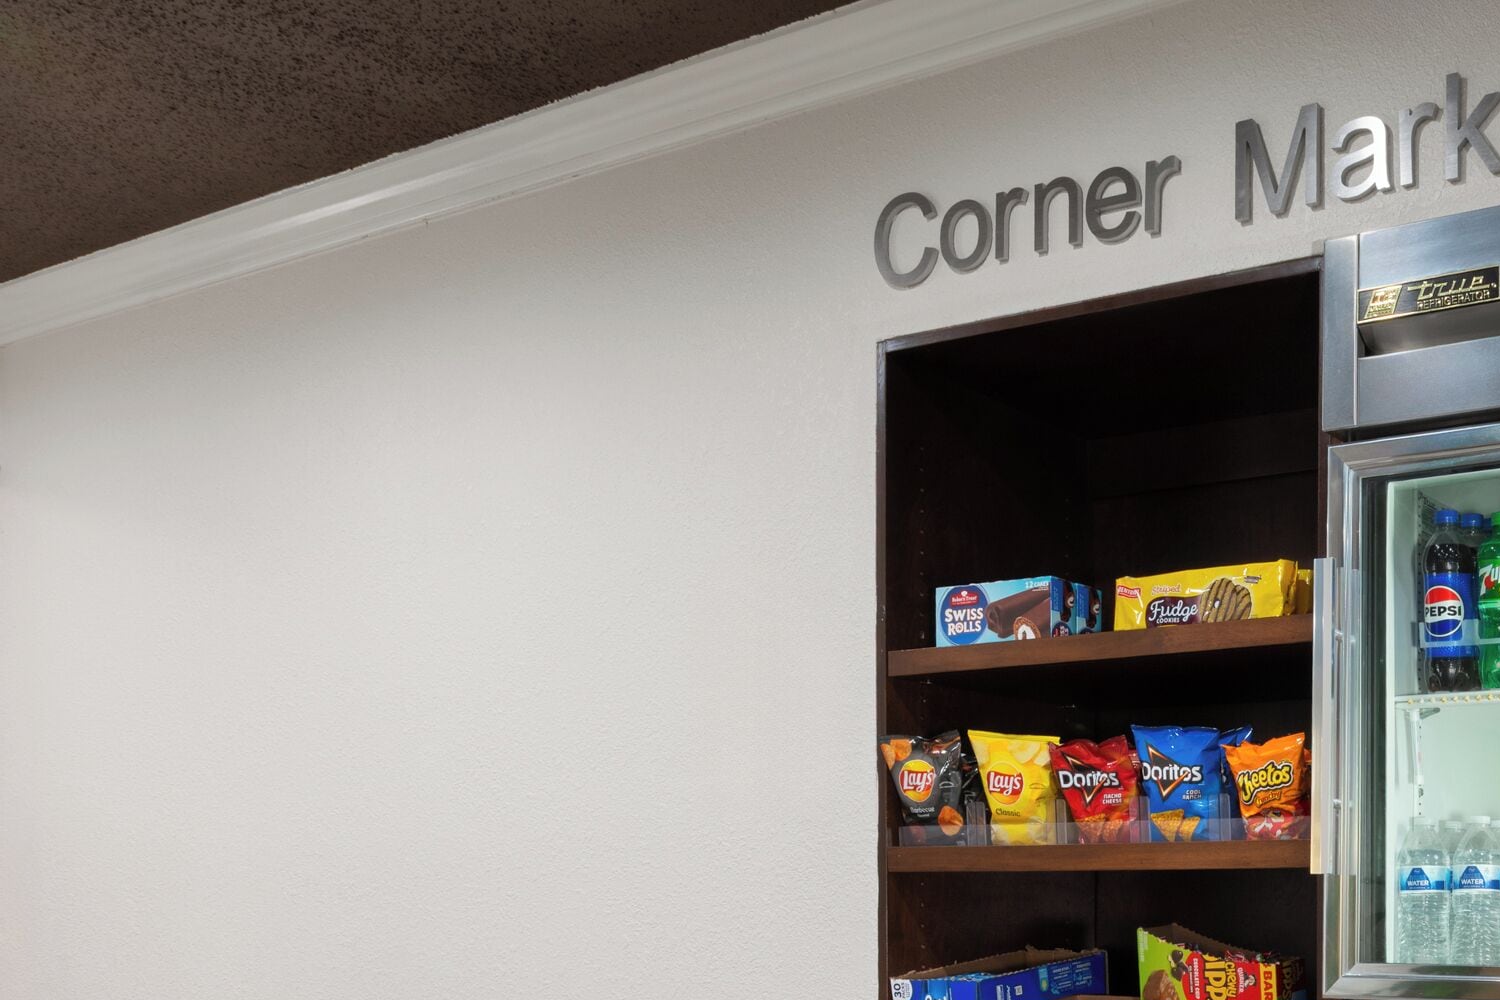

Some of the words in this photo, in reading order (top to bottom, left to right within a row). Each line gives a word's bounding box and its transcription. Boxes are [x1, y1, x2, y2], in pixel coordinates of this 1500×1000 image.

[874, 155, 1181, 290] Corner
[1416, 290, 1490, 311] REFRIGERATOR
[945, 607, 983, 622] SWISS
[1148, 600, 1198, 622] Fudge
[1425, 605, 1461, 617] PEPSI
[948, 620, 981, 636] ROLLS
[903, 770, 934, 792] Lay's
[1059, 769, 1120, 787] Doritos
[1142, 764, 1203, 782] Doritos
[1238, 763, 1290, 801] Cheetos
[988, 771, 1021, 795] Lay's
[995, 808, 1021, 817] Classic
[893, 983, 902, 998] 30
